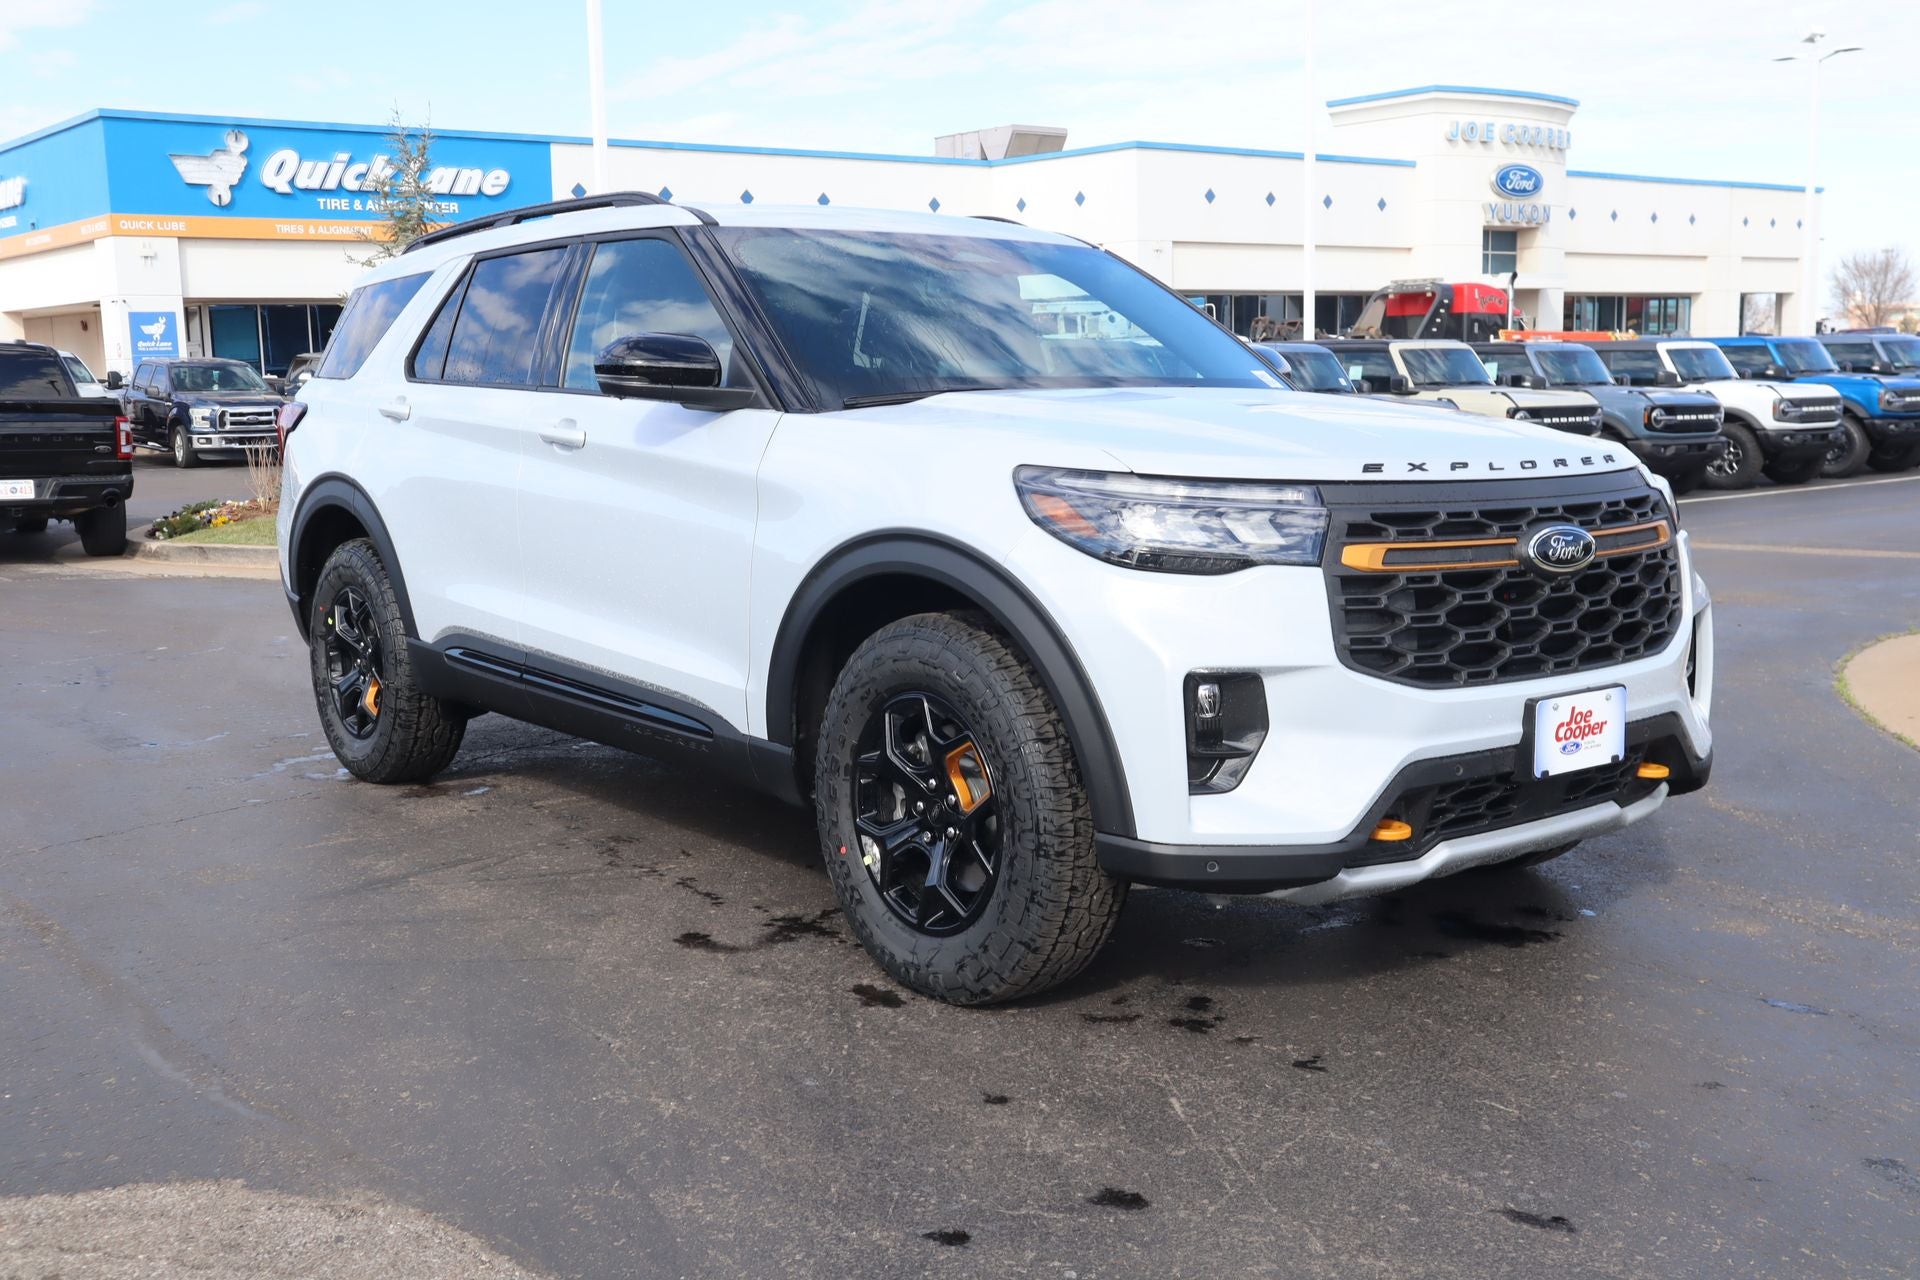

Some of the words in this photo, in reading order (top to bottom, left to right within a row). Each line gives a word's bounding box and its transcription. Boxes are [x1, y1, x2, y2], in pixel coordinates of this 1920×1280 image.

[1448, 121, 1495, 142] JOE
[260, 149, 398, 194] Quick
[316, 198, 350, 210] TIRE
[353, 198, 363, 211] &
[1485, 203, 1551, 223] YUKON
[119, 219, 154, 230] QUICK
[156, 221, 187, 231] LUBE
[275, 223, 304, 234] TIRES
[308, 225, 315, 234] &
[317, 225, 373, 235] ALIGNMENT
[1361, 454, 1616, 473] EXPLORER
[1548, 535, 1585, 560] Ford
[1565, 706, 1593, 727] Joe
[1555, 720, 1608, 742] Cooper
